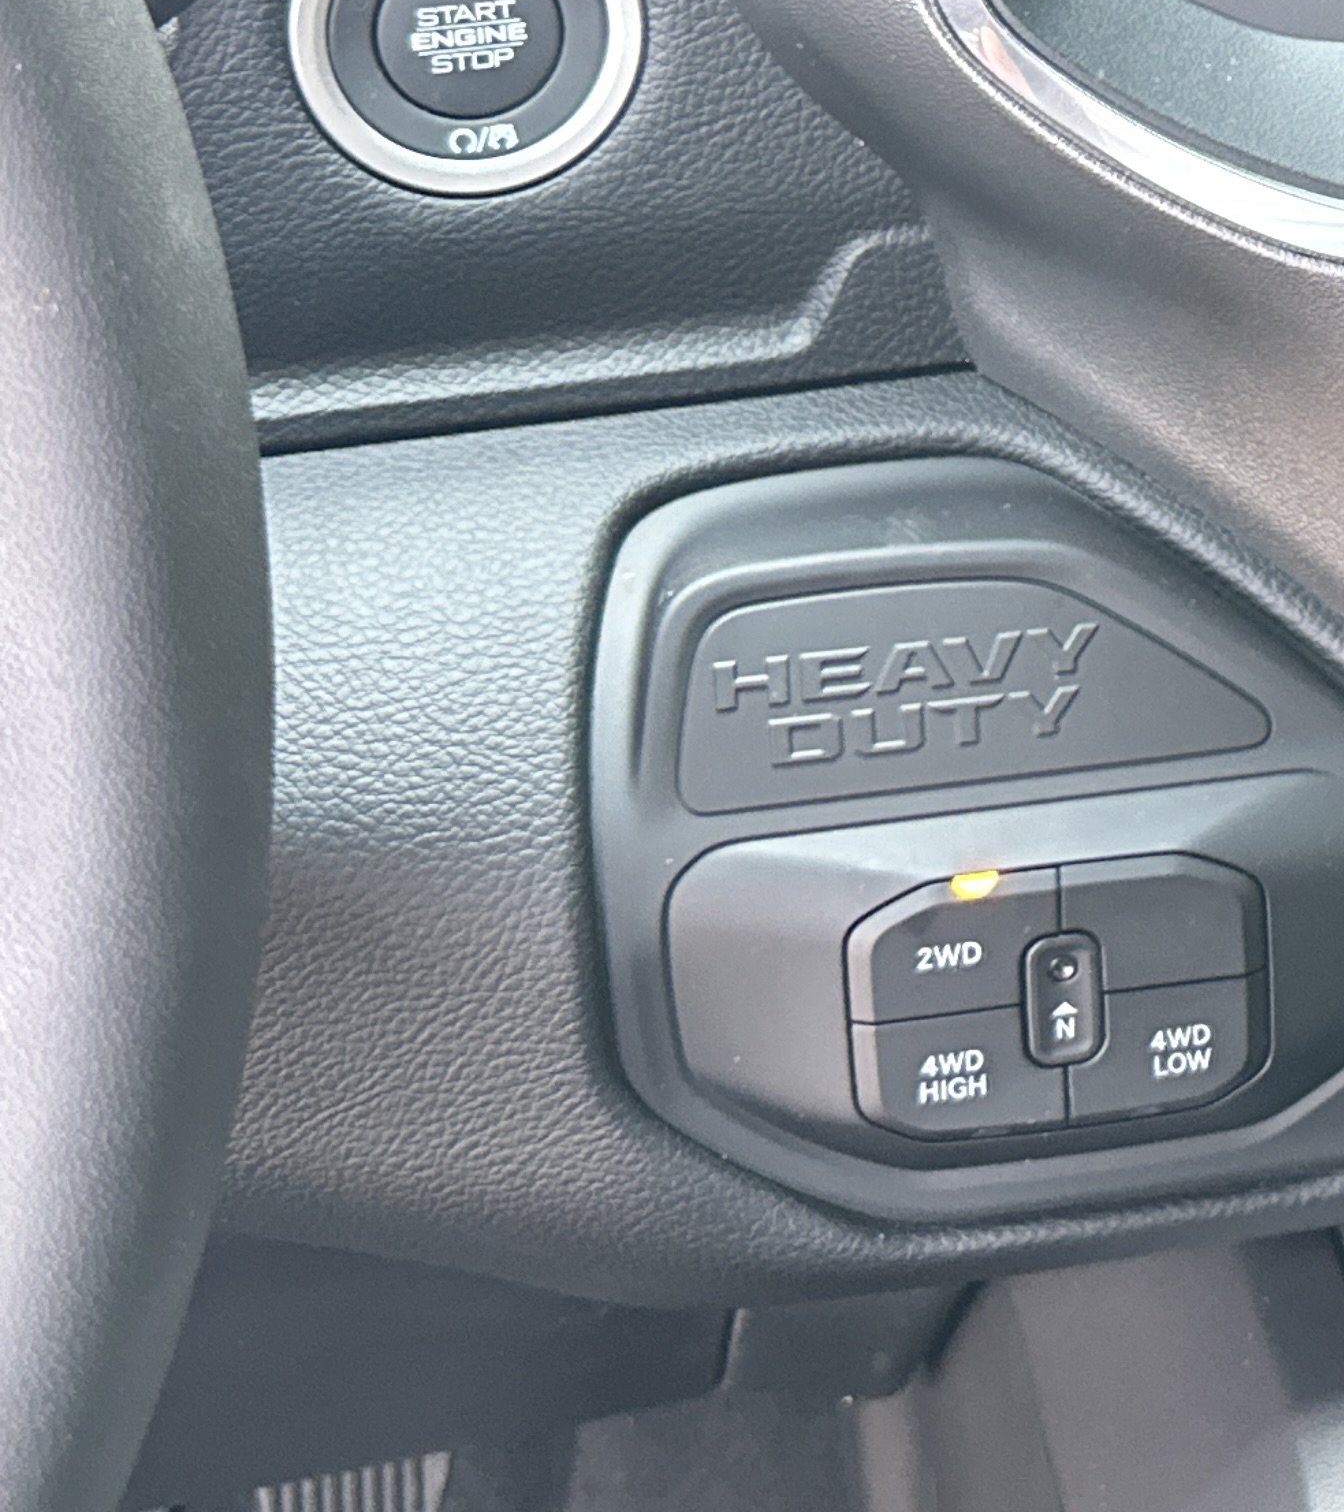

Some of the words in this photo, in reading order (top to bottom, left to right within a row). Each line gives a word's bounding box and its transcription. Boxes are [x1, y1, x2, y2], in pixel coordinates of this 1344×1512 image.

[409, 21, 529, 52] ENGINE
[430, 47, 515, 75] STOP
[712, 622, 1099, 713] HEAVY
[767, 686, 1080, 768] DUTY
[914, 941, 983, 971] 2WD
[1055, 1017, 1076, 1039] N
[1150, 1023, 1212, 1050] 4WD
[918, 1049, 985, 1077] 4WD
[1152, 1047, 1213, 1078] LOW
[917, 1073, 989, 1105] HIGH
